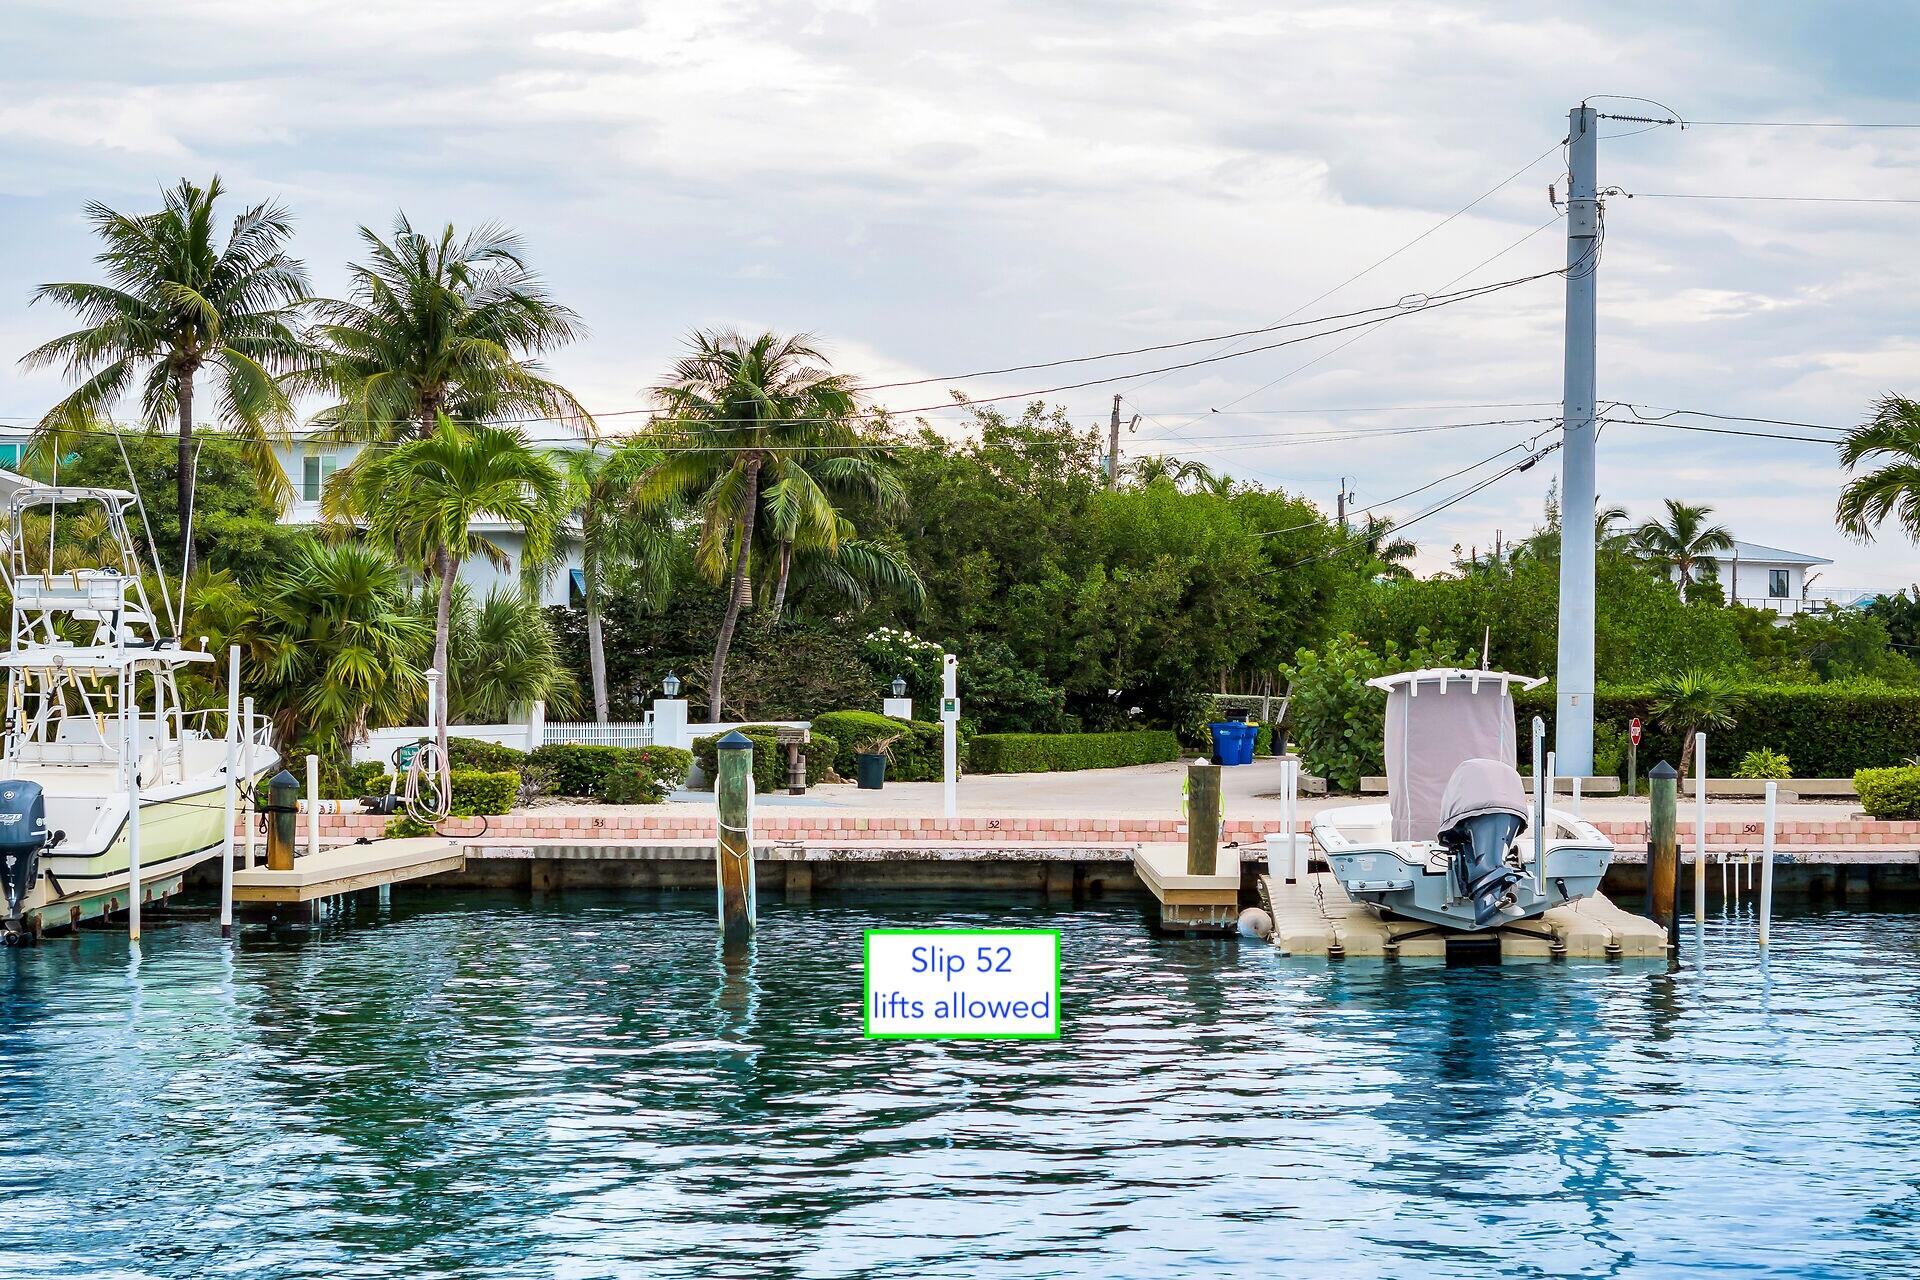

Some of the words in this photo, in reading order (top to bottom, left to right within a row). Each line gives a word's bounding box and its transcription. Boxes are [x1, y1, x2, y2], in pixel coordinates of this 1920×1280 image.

[593, 818, 604, 828] 53
[988, 820, 1000, 829] 52
[1743, 824, 1757, 833] 50
